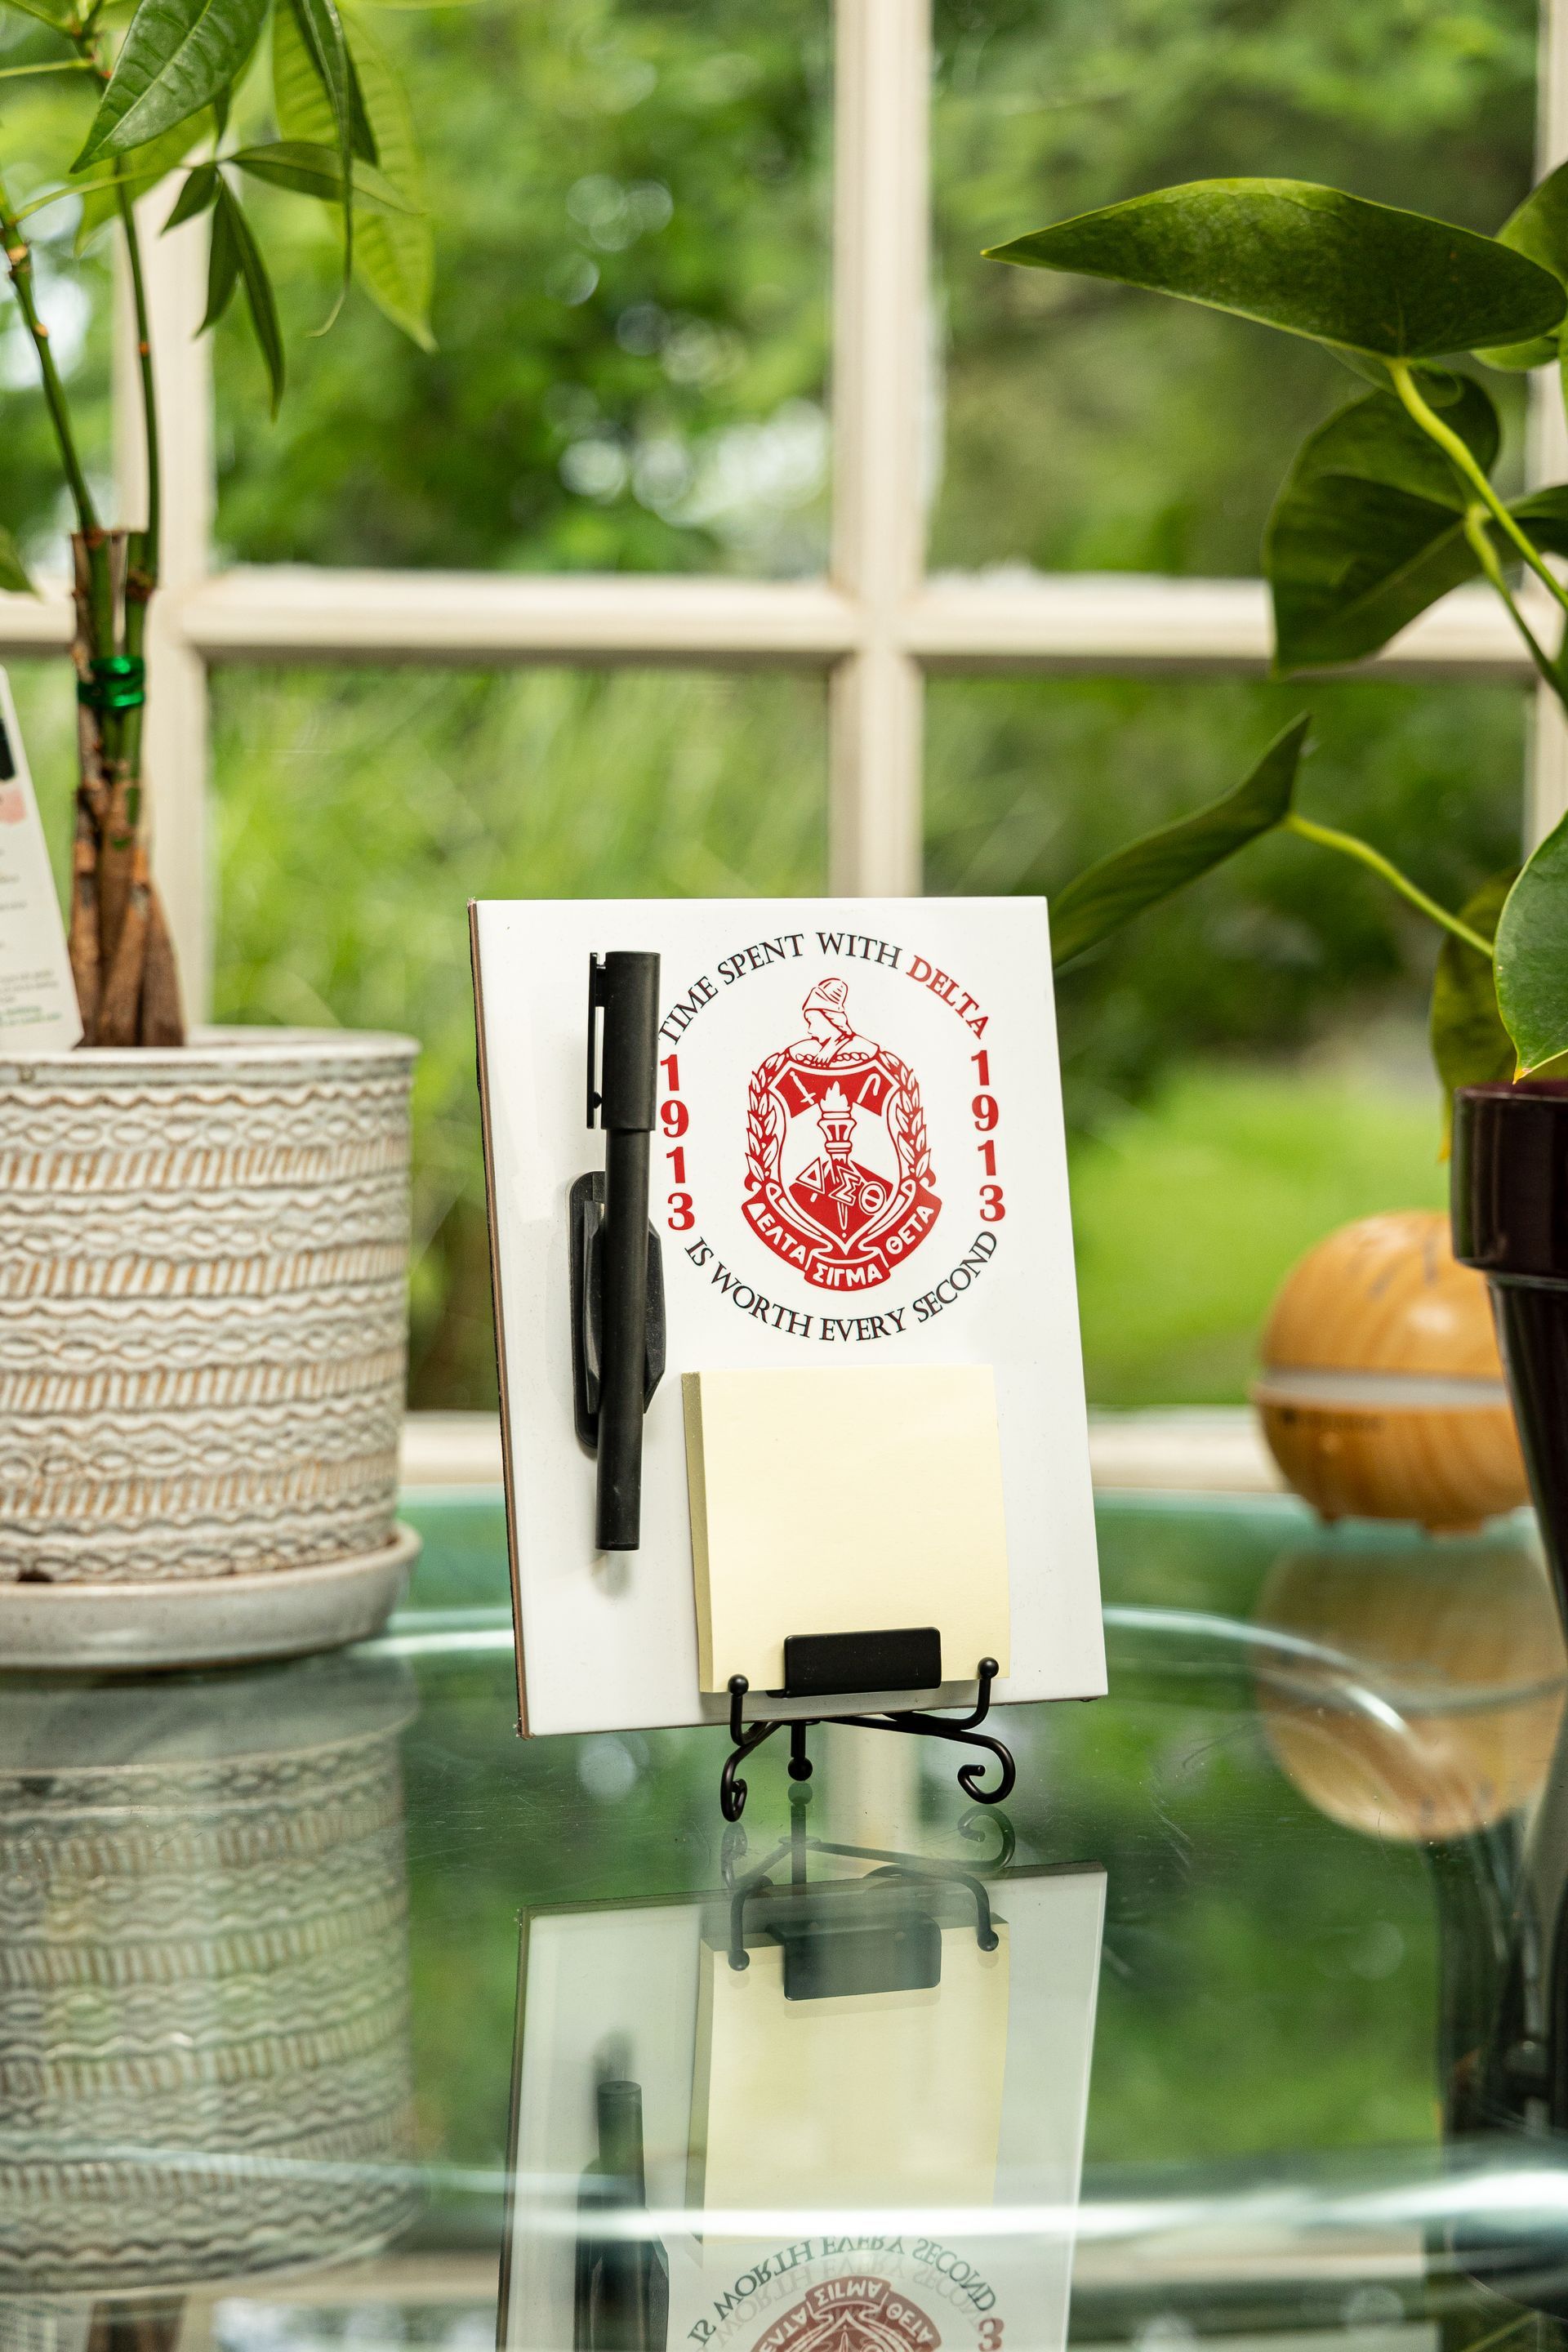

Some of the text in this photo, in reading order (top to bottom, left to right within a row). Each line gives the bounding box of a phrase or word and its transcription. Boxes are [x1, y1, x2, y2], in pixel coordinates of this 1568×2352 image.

[658, 932, 989, 1045] TIME SPENT WITH DELTA
[660, 1054, 695, 1231] 1913
[970, 1049, 1006, 1223] 1913
[684, 1231, 998, 1342] IS WORTH EVERY SECOND
